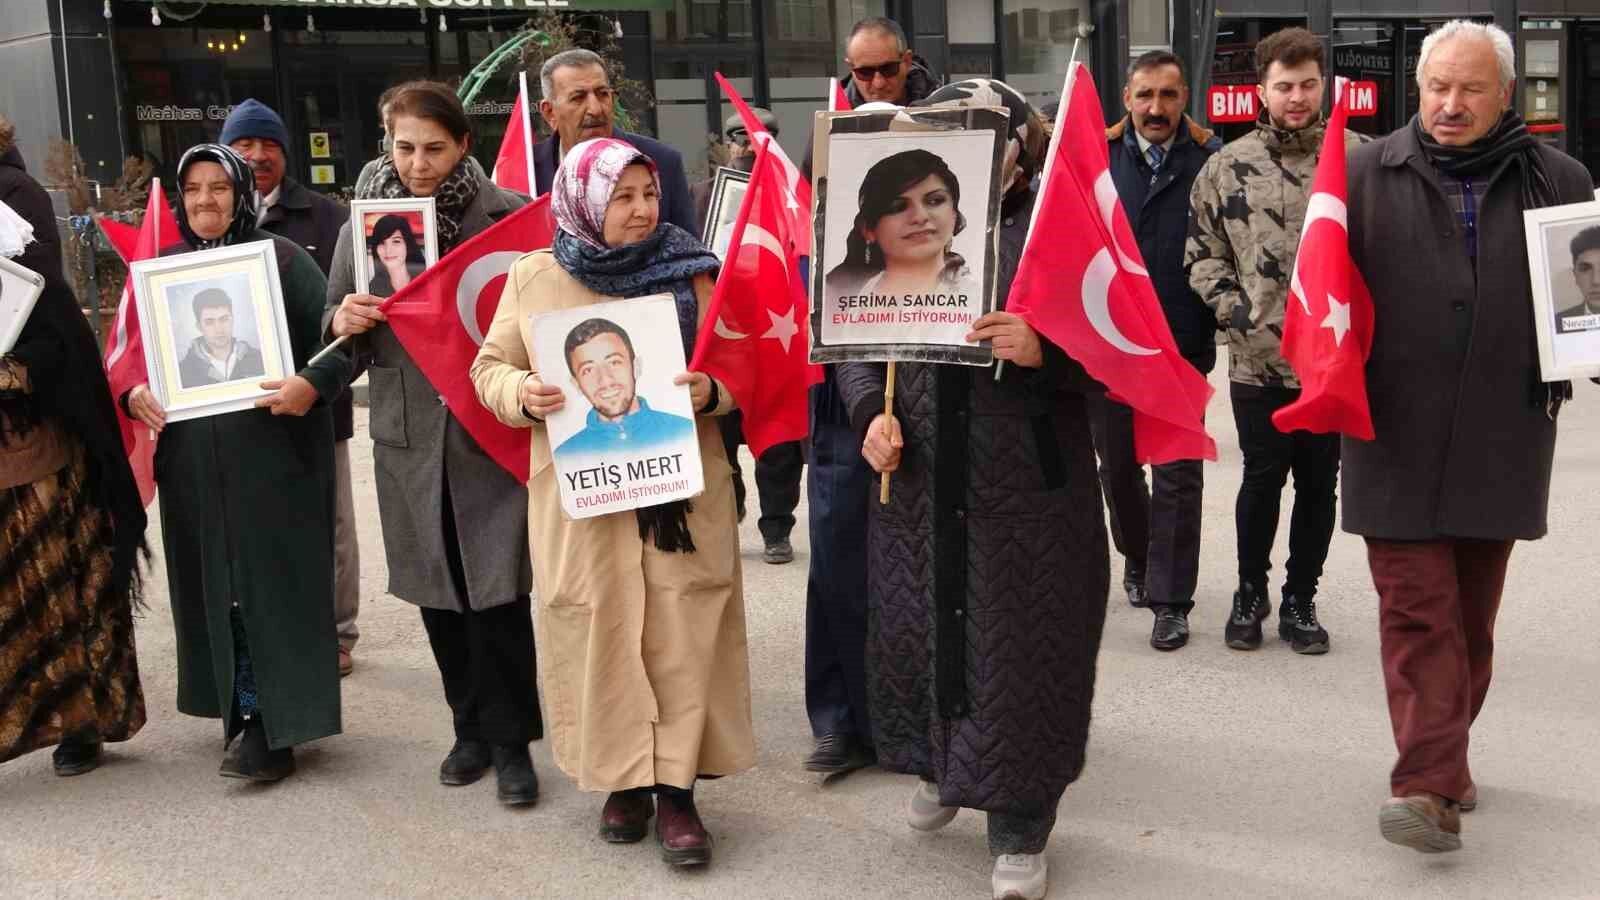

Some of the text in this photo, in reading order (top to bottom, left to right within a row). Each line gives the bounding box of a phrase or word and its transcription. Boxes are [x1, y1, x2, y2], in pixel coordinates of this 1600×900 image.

[1212, 85, 1254, 116] BİM
[1349, 81, 1374, 110] İM
[838, 292, 968, 311] ŞERİMA SANCAR
[832, 310, 972, 324] EVLADIMI İSTİYORUM!
[565, 454, 683, 491] YETİŞ MERT
[576, 479, 689, 508] EVLADIMI İSTİYORUM!
